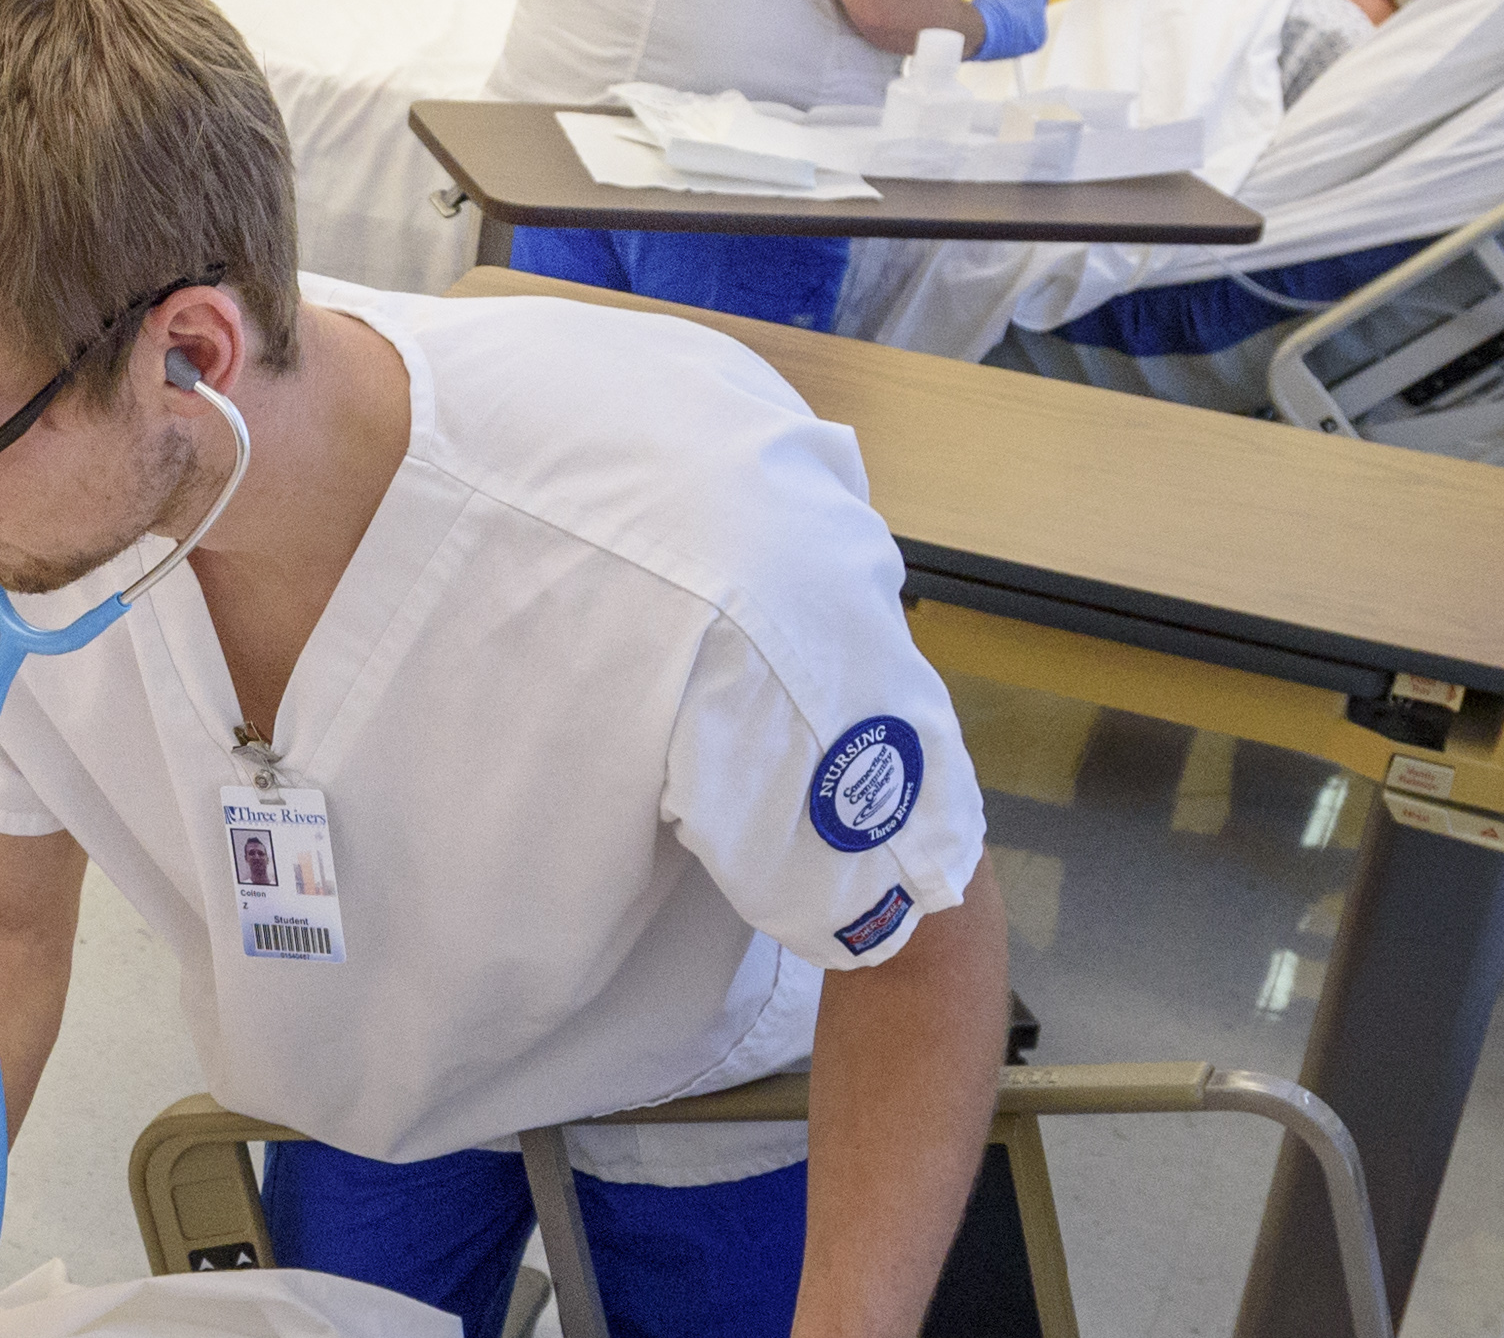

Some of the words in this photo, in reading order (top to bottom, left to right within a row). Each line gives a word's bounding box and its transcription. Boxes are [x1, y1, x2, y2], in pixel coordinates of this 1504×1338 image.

[819, 725, 887, 798] NURSING
[843, 745, 888, 798] Connecticut
[849, 752, 893, 805] Community
[865, 764, 895, 804] Colleges
[235, 806, 277, 822] Three
[281, 808, 327, 825] Rivers
[867, 818, 897, 841] Three
[895, 782, 915, 821] Rivers
[273, 915, 309, 926] Student
